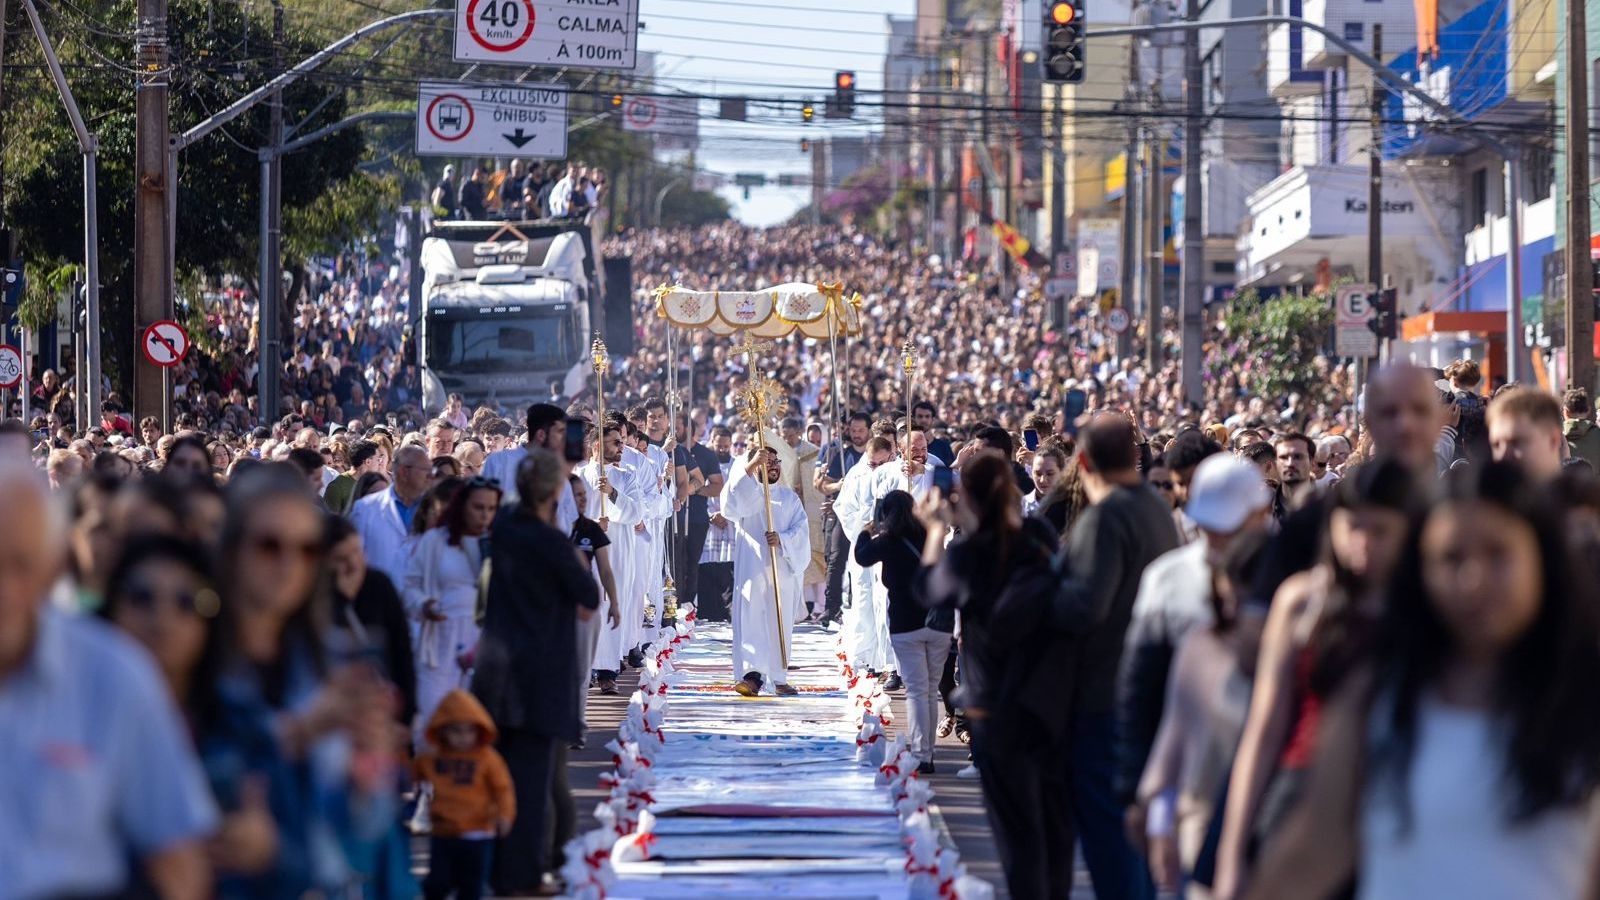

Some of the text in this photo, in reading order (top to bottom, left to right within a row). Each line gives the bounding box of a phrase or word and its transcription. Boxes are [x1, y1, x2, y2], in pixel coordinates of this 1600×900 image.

[480, 0, 519, 28] 40
[558, 16, 622, 33] CALMA
[486, 29, 513, 39] km/h
[576, 44, 622, 60] 100m
[480, 89, 560, 104] EXCLUSIVO
[493, 105, 547, 123] ÔNIBUS
[1344, 198, 1414, 213] Katen
[1350, 294, 1362, 313] E
